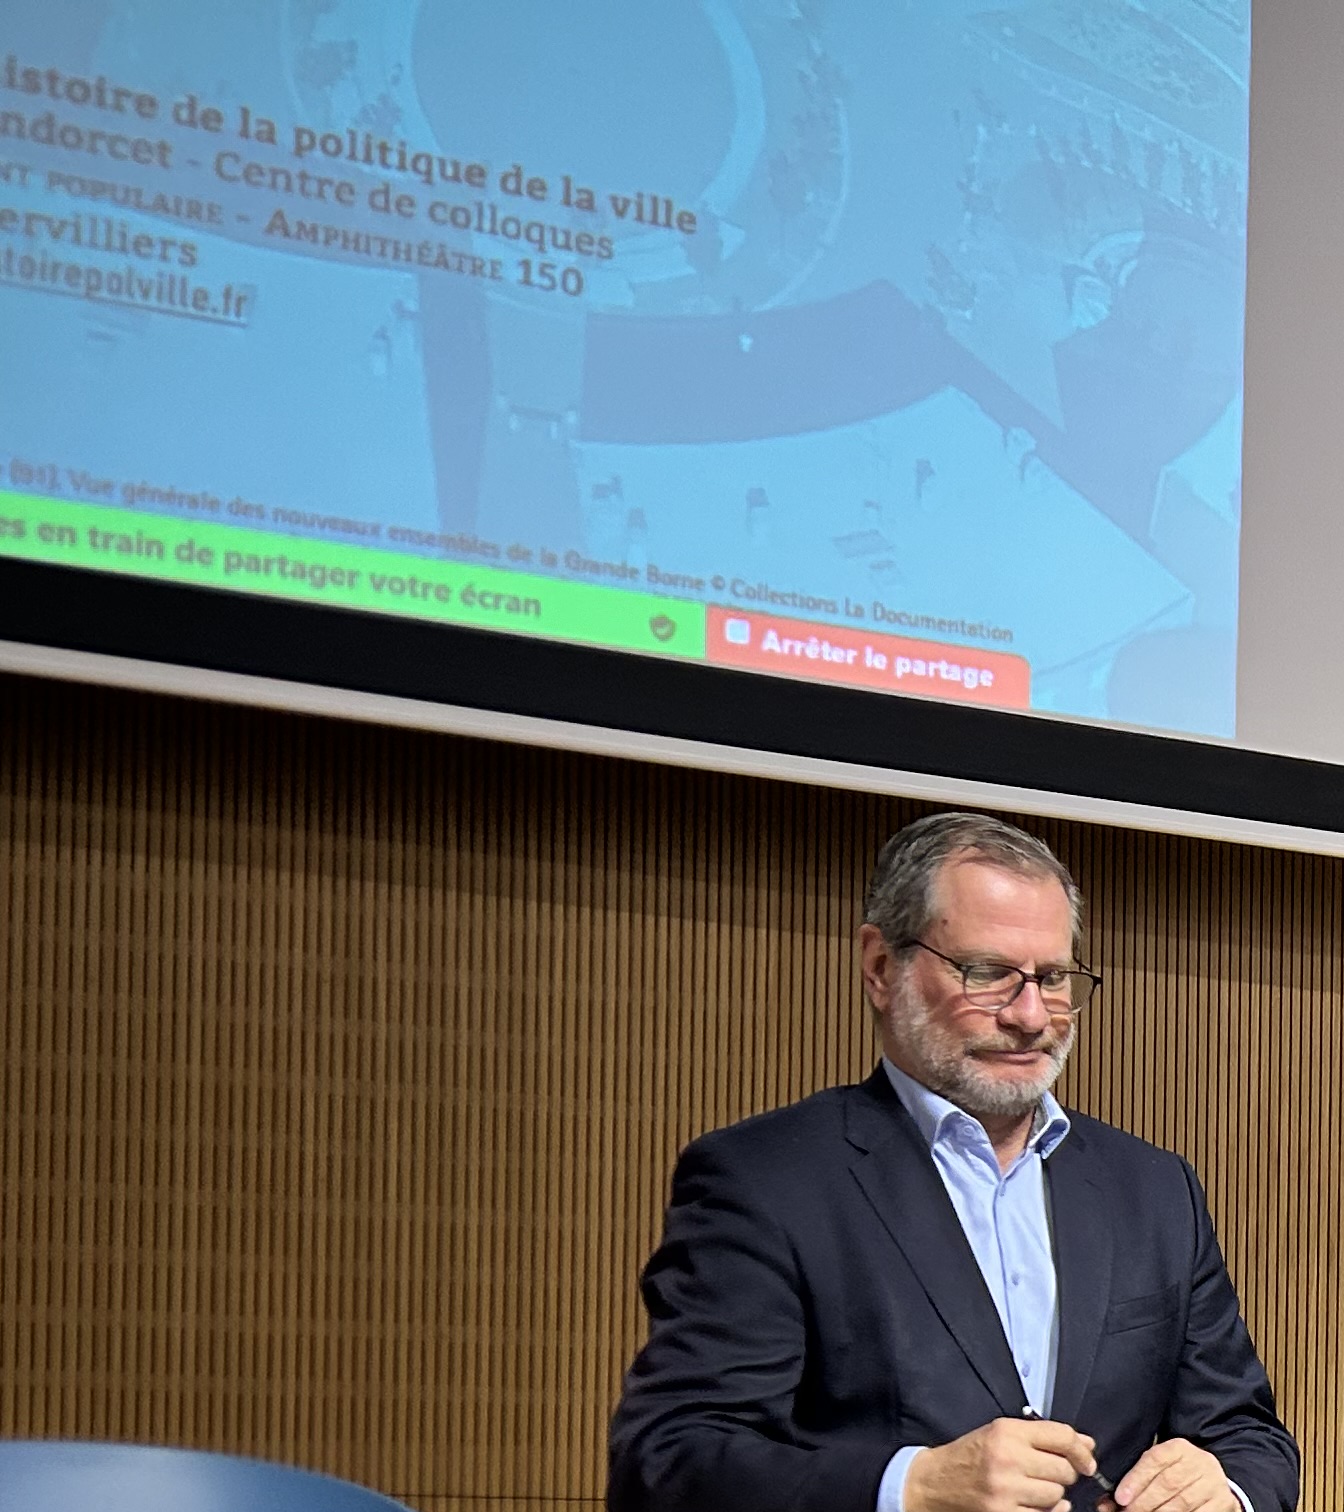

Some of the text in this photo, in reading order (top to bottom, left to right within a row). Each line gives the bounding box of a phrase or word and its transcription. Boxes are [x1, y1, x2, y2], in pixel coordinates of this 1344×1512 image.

[0, 110, 173, 169] ndorcet
[214, 150, 356, 206] Centre
[367, 181, 418, 218] de
[428, 199, 615, 259] colloques
[5, 53, 697, 234] istoire de la politique de la ville
[0, 207, 198, 267] ervilliers
[517, 258, 585, 298] 150
[37, 522, 76, 546] en
[89, 526, 165, 560] train
[174, 538, 214, 566] de
[225, 550, 361, 589] partager
[370, 570, 451, 602] votre
[460, 581, 542, 618] écran
[65, 467, 113, 495] Vue
[121, 480, 221, 514] générale
[227, 495, 265, 521] des
[272, 507, 381, 537] nouveaux
[387, 522, 500, 560] ensembles
[506, 543, 533, 563] de
[539, 548, 557, 568] la
[564, 550, 640, 582] Grande
[646, 564, 706, 591] Borne
[730, 577, 839, 616] Collections
[845, 595, 865, 619] La
[873, 600, 1013, 643] Documentation
[761, 628, 995, 689] Arrêter le partage
